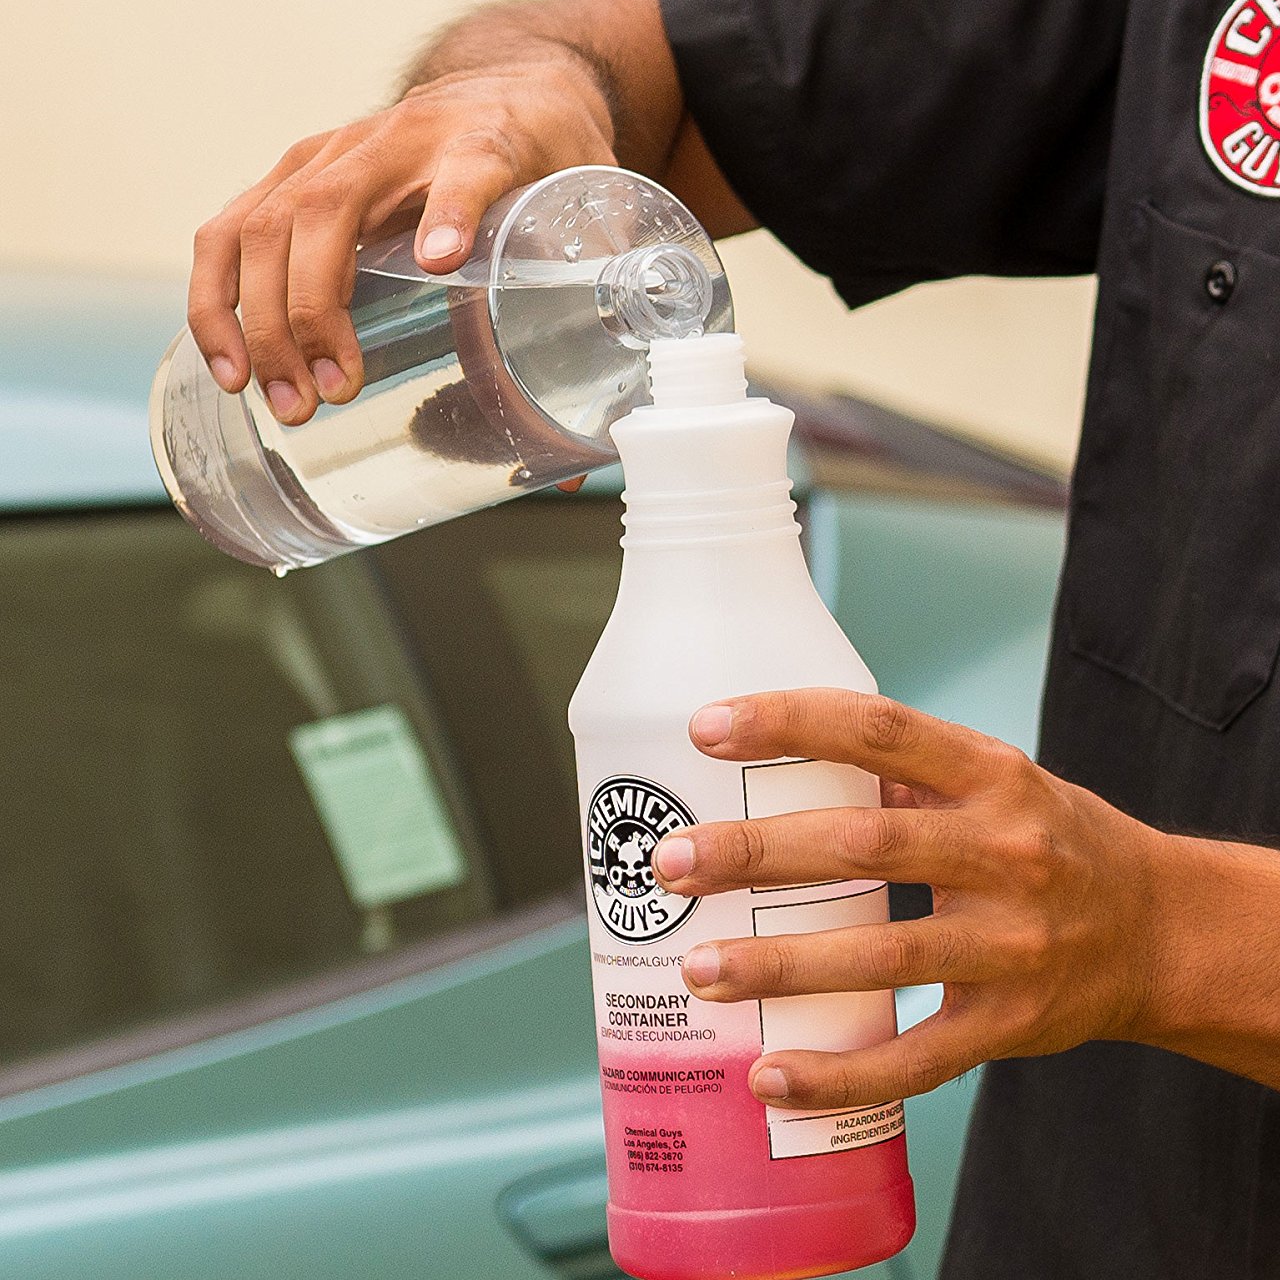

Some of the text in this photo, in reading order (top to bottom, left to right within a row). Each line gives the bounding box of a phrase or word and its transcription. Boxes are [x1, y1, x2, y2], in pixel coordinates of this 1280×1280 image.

[590, 788, 686, 860] CHEMICA
[608, 898, 669, 931] GUYS
[605, 992, 690, 1009] SECONDARY
[608, 1011, 688, 1027] CONTAINER
[635, 1028, 716, 1042] SECUNDARIO)
[626, 1068, 725, 1082] COMMUNICATION
[659, 1085, 672, 1095] DE
[674, 1083, 722, 1095] PELIGRO)
[836, 1111, 886, 1130] HAZARDOUS
[624, 1126, 683, 1139] Chemical Guys
[830, 1123, 889, 1148] (INGREDIENTES
[623, 1138, 687, 1150] Los Angeles, CA
[645, 1151, 683, 1161] 822-3670
